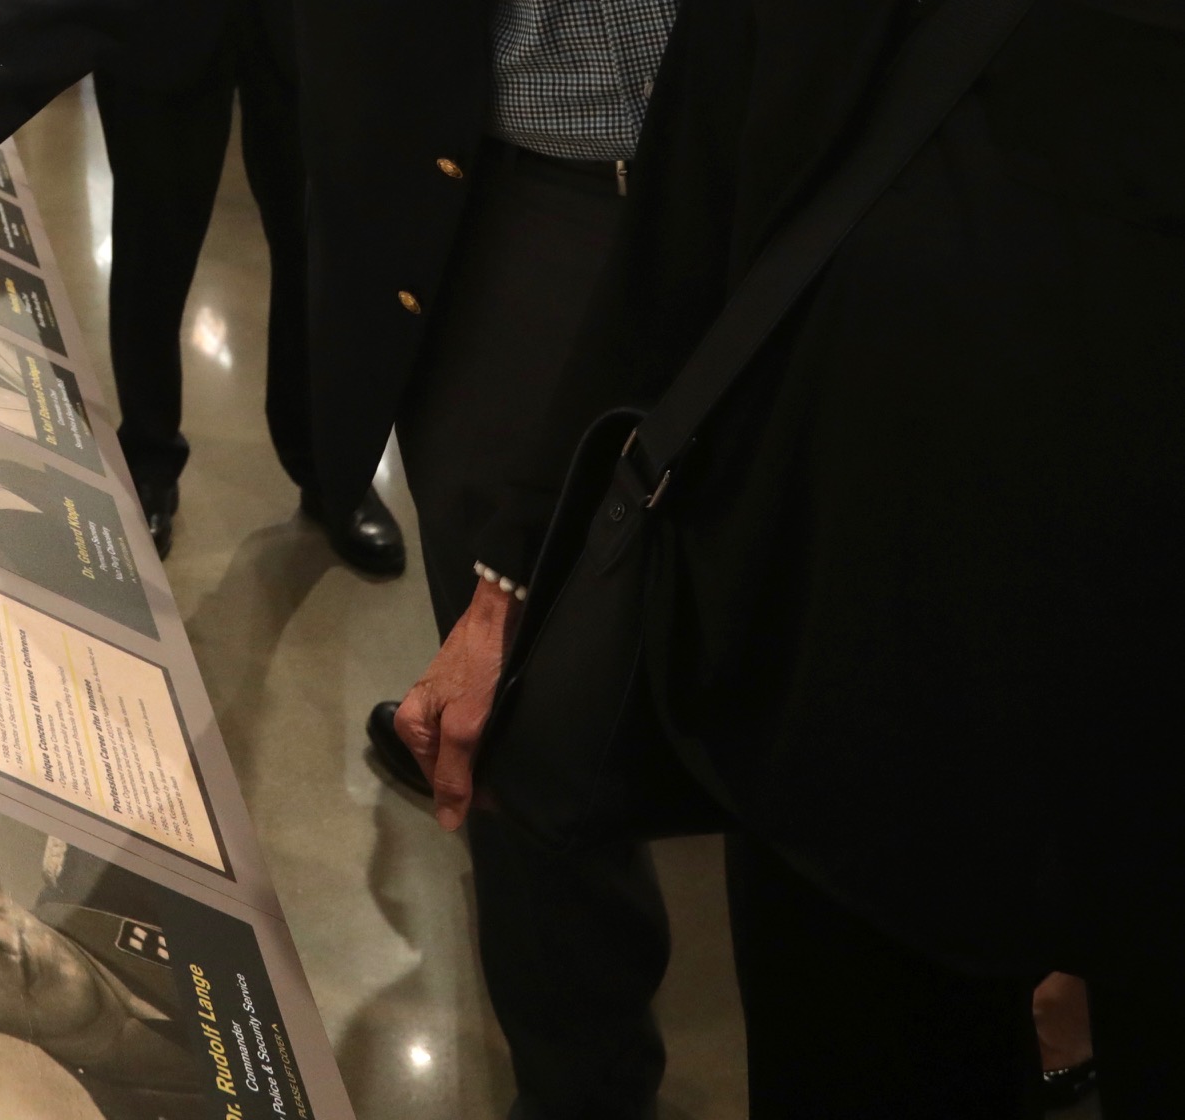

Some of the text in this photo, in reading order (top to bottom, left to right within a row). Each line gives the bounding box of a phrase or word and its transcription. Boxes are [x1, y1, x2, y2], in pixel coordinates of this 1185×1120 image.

[63, 496, 95, 579] Dr. Gerhard Klopfer
[20, 629, 55, 784] Unique Concerns at Wannsee Conference
[85, 678, 122, 814] Professional Career after Wannsee
[189, 964, 217, 1022] Lange
[201, 1023, 237, 1096] Rudolf
[231, 1020, 259, 1092] Commander
[235, 973, 286, 1115] Police & Security Service
[274, 1034, 307, 1119] PLEASE LIFT COVER
